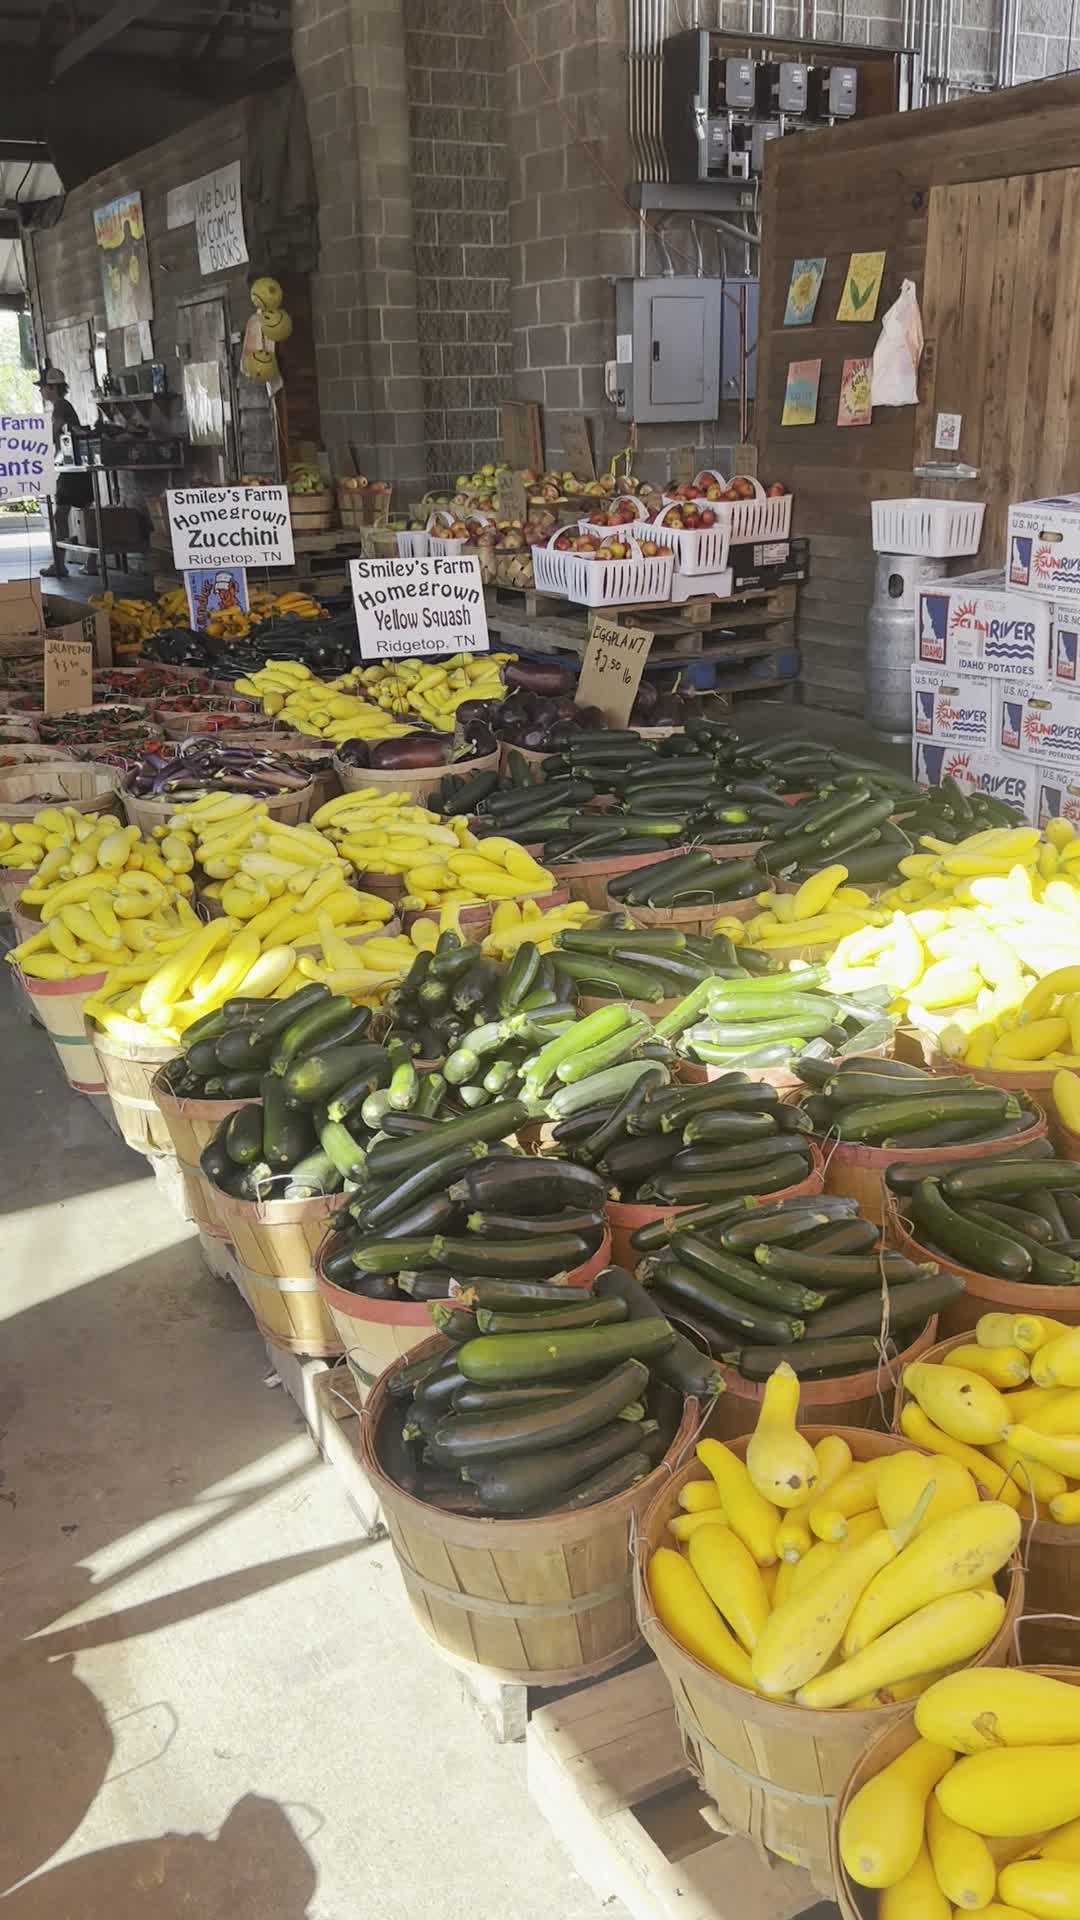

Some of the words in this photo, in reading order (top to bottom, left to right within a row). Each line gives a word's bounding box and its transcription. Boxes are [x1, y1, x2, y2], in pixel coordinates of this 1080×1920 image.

[214, 175, 238, 214] buy
[209, 236, 242, 271] BOOKS
[1, 417, 45, 431] Farm
[17, 481, 41, 493] TN
[174, 489, 240, 505] Smiley's
[245, 488, 282, 502] Farm
[173, 506, 287, 530] Homegrown
[188, 526, 279, 548] Zucchini
[189, 554, 257, 566] Ridgetop,
[261, 551, 282, 562] TN
[358, 560, 429, 578] Smiley's
[434, 560, 474, 575] Farm
[358, 581, 480, 610] Homegrown
[374, 608, 418, 631] Yellow
[422, 603, 471, 628] Squash
[376, 639, 449, 654] Ridgetop,
[453, 634, 475, 647] TN
[592, 626, 646, 654] EGGPLANT
[594, 648, 621, 673] $2.50
[958, 659, 985, 672] IDAHO
[987, 661, 1035, 675] POTATOES
[941, 708, 987, 724] SUNRIVER
